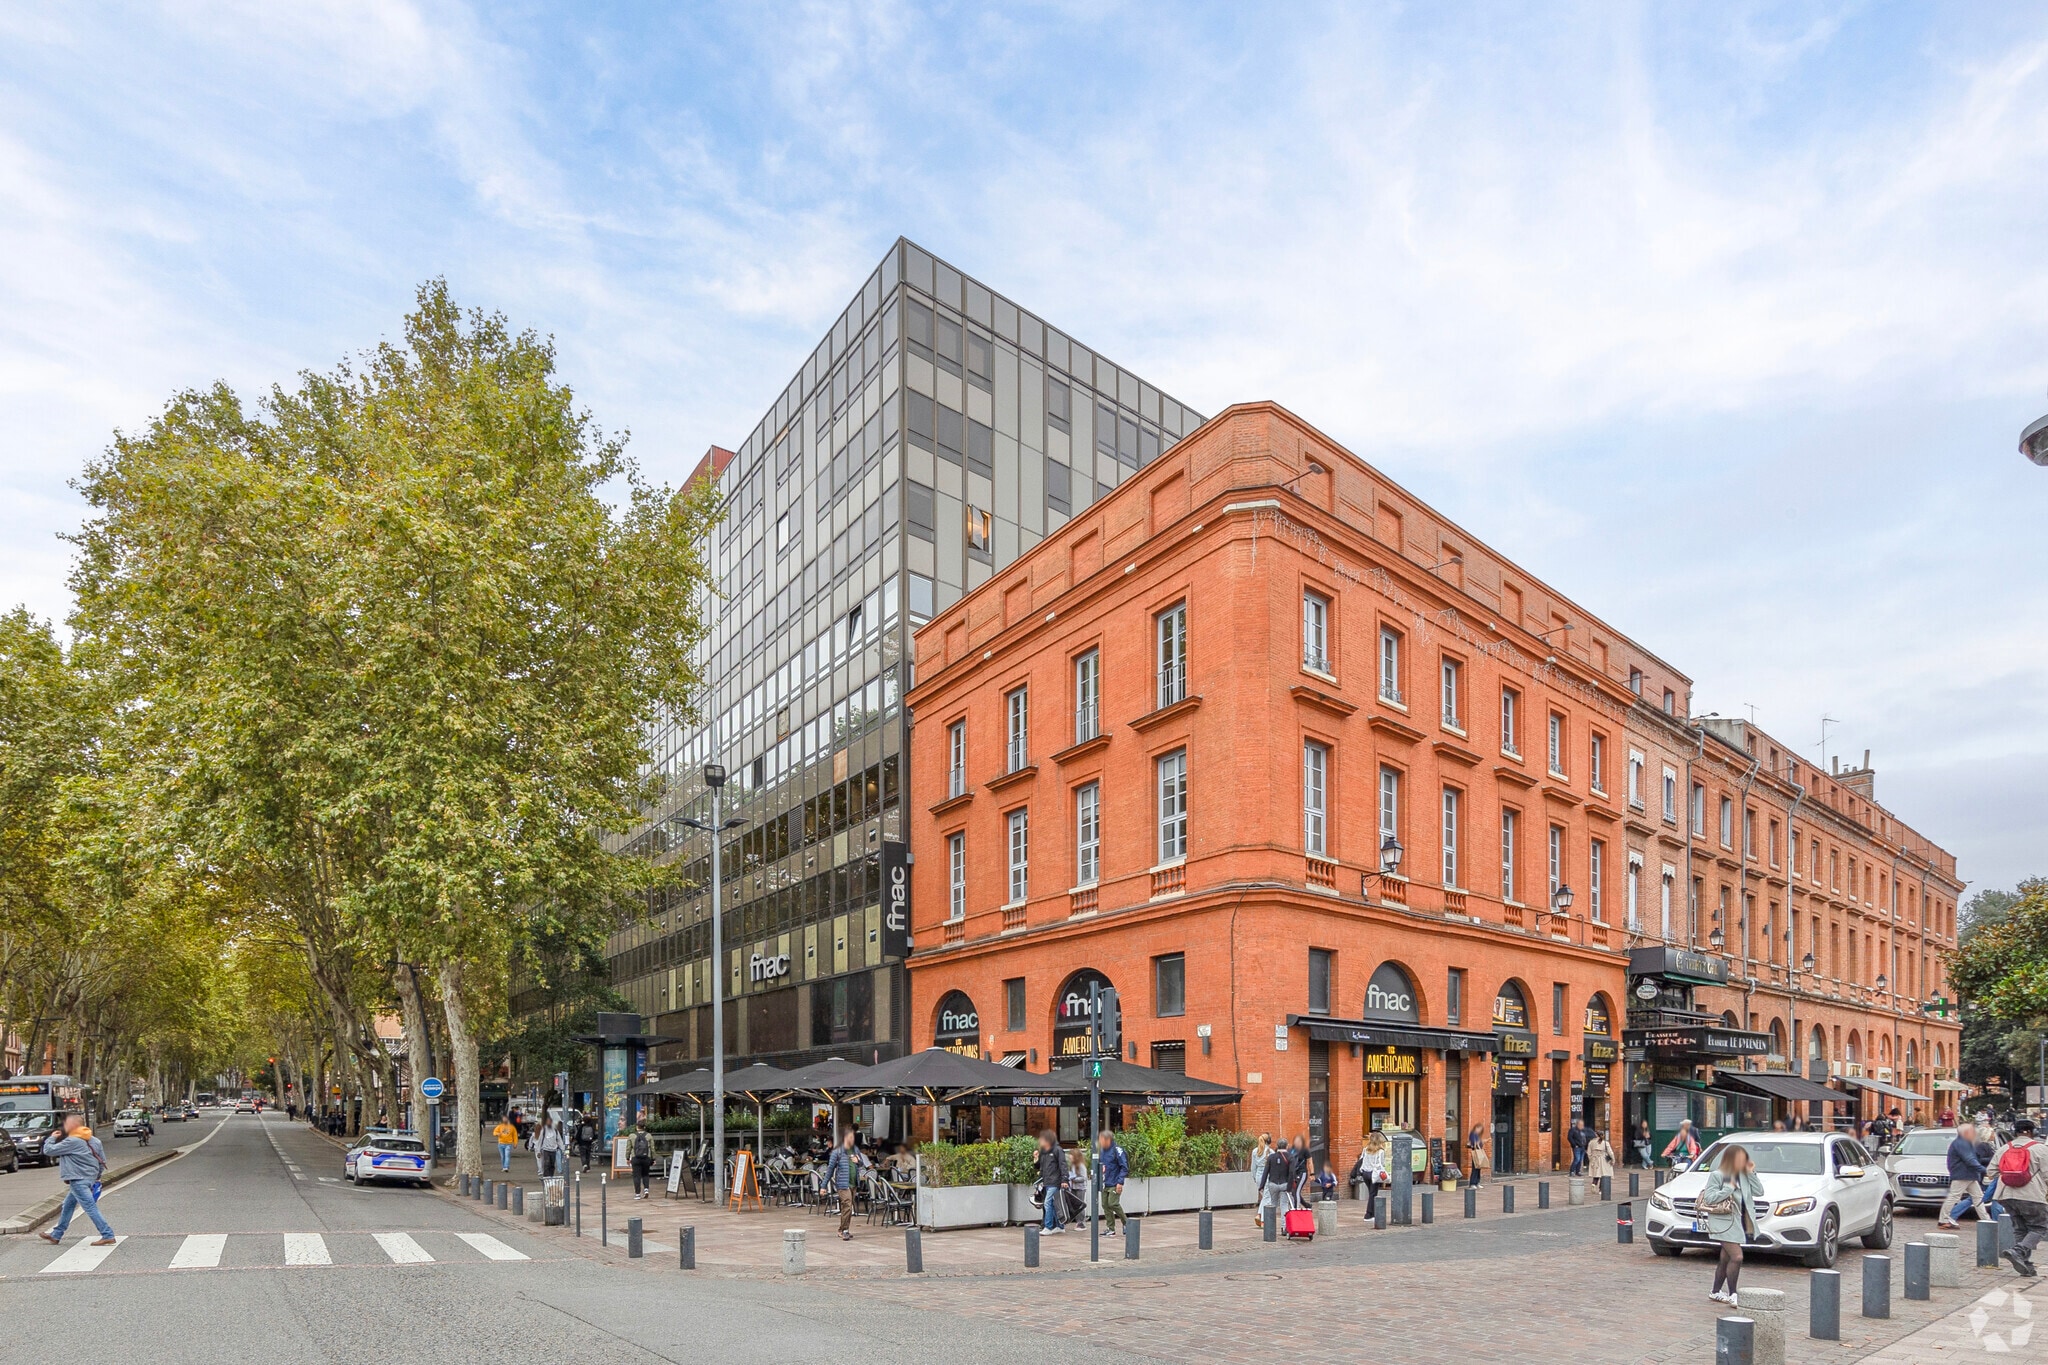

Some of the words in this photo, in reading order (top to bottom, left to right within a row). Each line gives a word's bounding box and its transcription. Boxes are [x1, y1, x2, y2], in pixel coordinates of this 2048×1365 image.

[886, 866, 905, 931] fnac
[750, 953, 790, 981] fnac
[1065, 993, 1102, 1016] fna
[1368, 984, 1410, 1011] fnac
[943, 1010, 978, 1030] fnac
[1504, 1034, 1531, 1052] fnac
[1592, 1041, 1615, 1058] fnac
[1367, 1054, 1415, 1073] AMERICAINS
